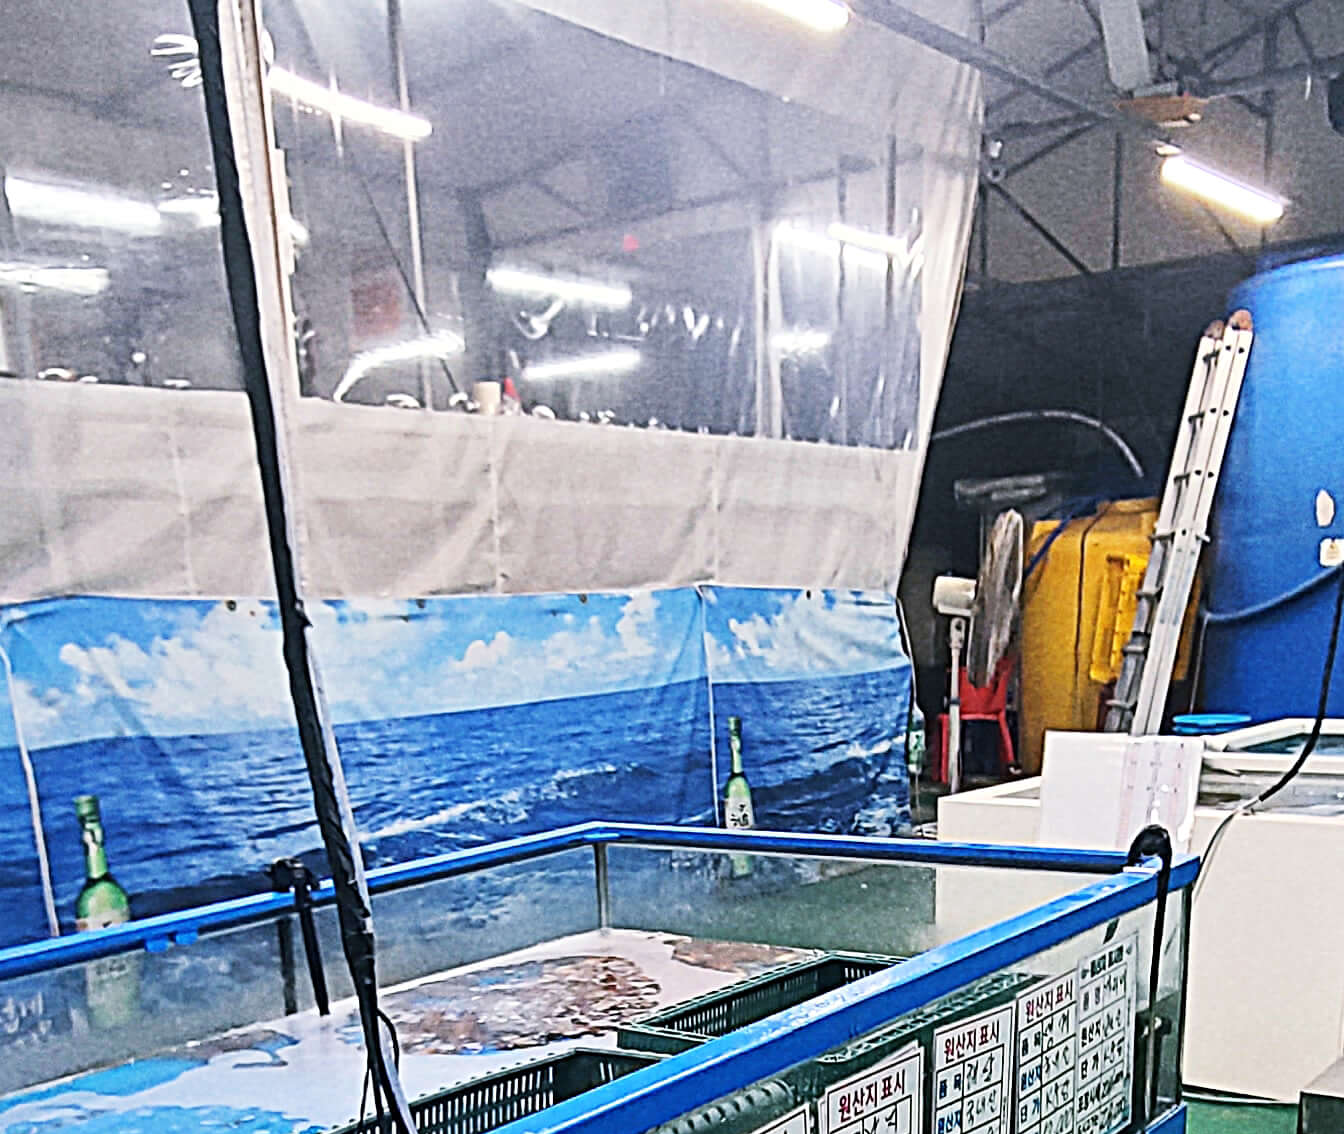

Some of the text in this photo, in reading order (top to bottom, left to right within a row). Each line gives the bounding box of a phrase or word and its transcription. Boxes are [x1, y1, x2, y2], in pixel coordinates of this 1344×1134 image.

[1025, 979, 1073, 1024] 원산지 표시
[944, 1020, 999, 1064] 원산지 표시
[838, 1069, 905, 1123] 원산지 표시
